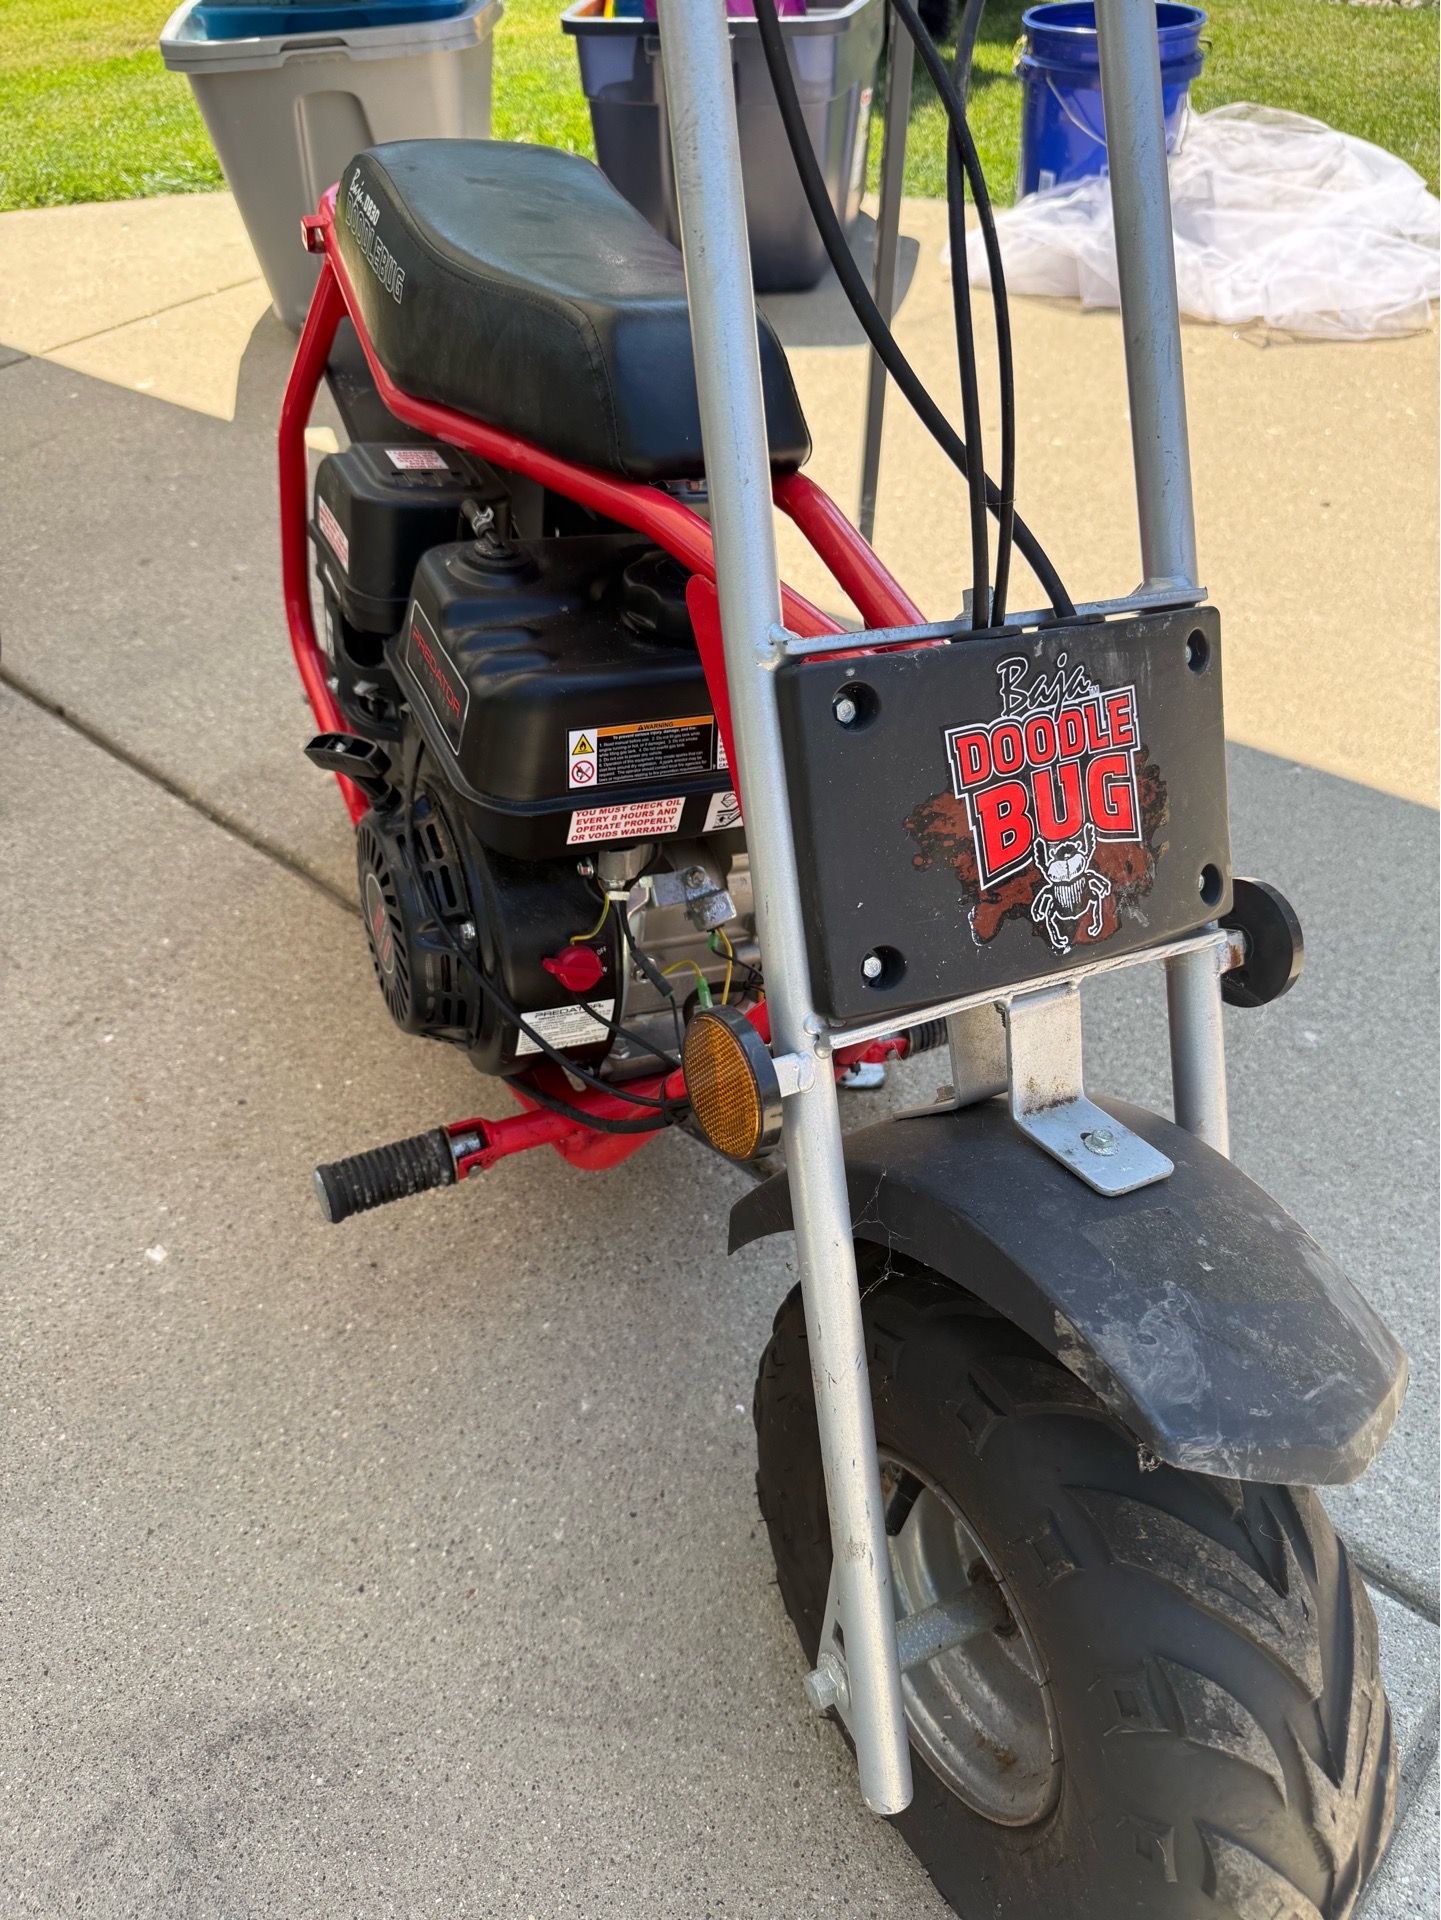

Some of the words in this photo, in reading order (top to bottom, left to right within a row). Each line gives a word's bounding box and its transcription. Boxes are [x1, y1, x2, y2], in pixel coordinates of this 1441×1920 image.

[346, 191, 406, 304] DOODLEBUG
[996, 652, 1091, 722] Baja
[643, 721, 674, 730] WARNING
[953, 691, 1136, 787] DOODLE
[576, 809, 596, 817] YOU
[599, 805, 627, 815] MUST
[630, 801, 663, 811] CHECK
[666, 799, 682, 807] OIL
[576, 816, 607, 826] EVERY
[612, 814, 618, 822] 8
[620, 810, 654, 820] HOURS
[657, 807, 678, 816] AND
[973, 752, 1136, 877] BUG
[576, 823, 620, 833] OPERATE
[624, 816, 675, 828] PROPERLY
[571, 834, 585, 842] OR
[588, 830, 618, 840] VOIDS
